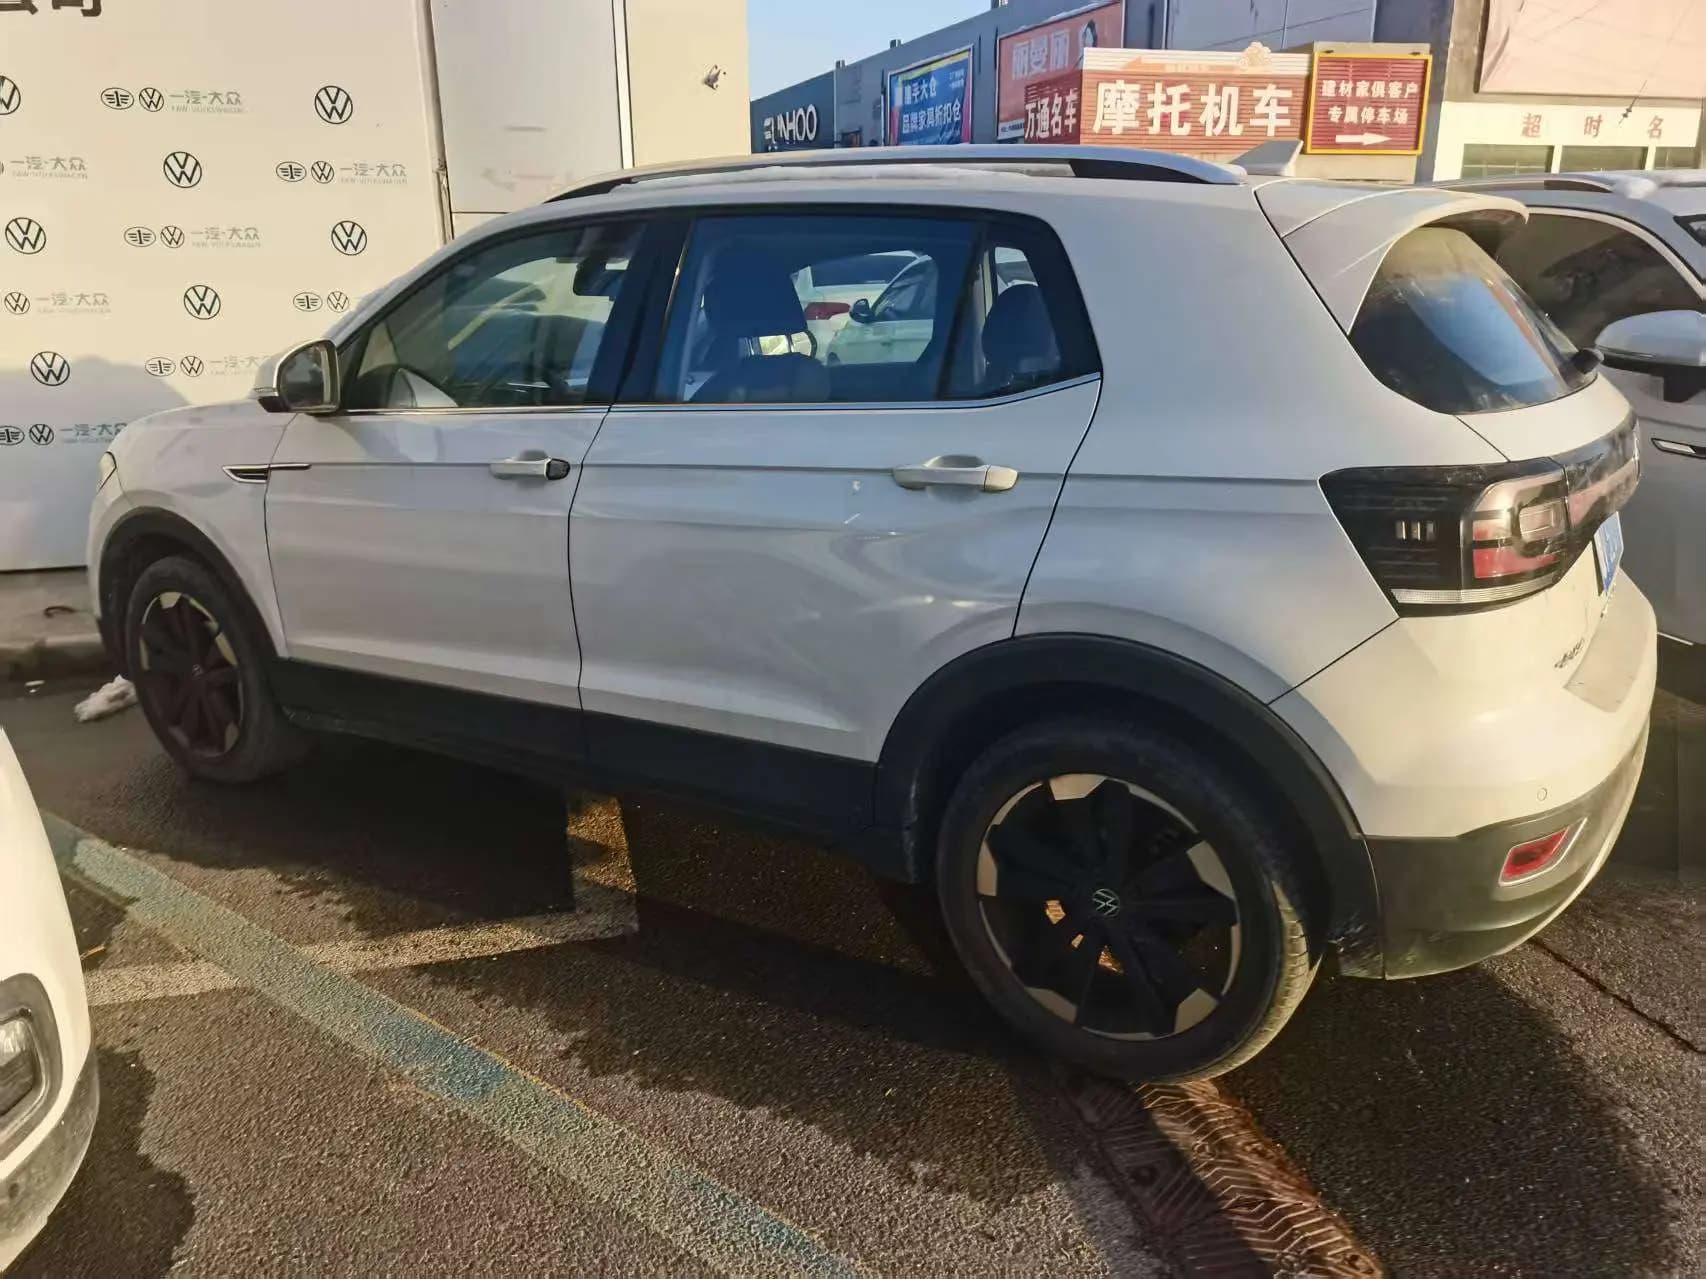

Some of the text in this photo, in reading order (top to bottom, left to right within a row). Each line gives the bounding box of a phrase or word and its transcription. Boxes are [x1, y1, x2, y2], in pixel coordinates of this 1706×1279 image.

[1321, 79, 1419, 98] 建材家俱客户
[1025, 88, 1077, 139] 万通名车
[1093, 80, 1292, 136] 摩托机车
[1328, 105, 1409, 124] 专属停车场
